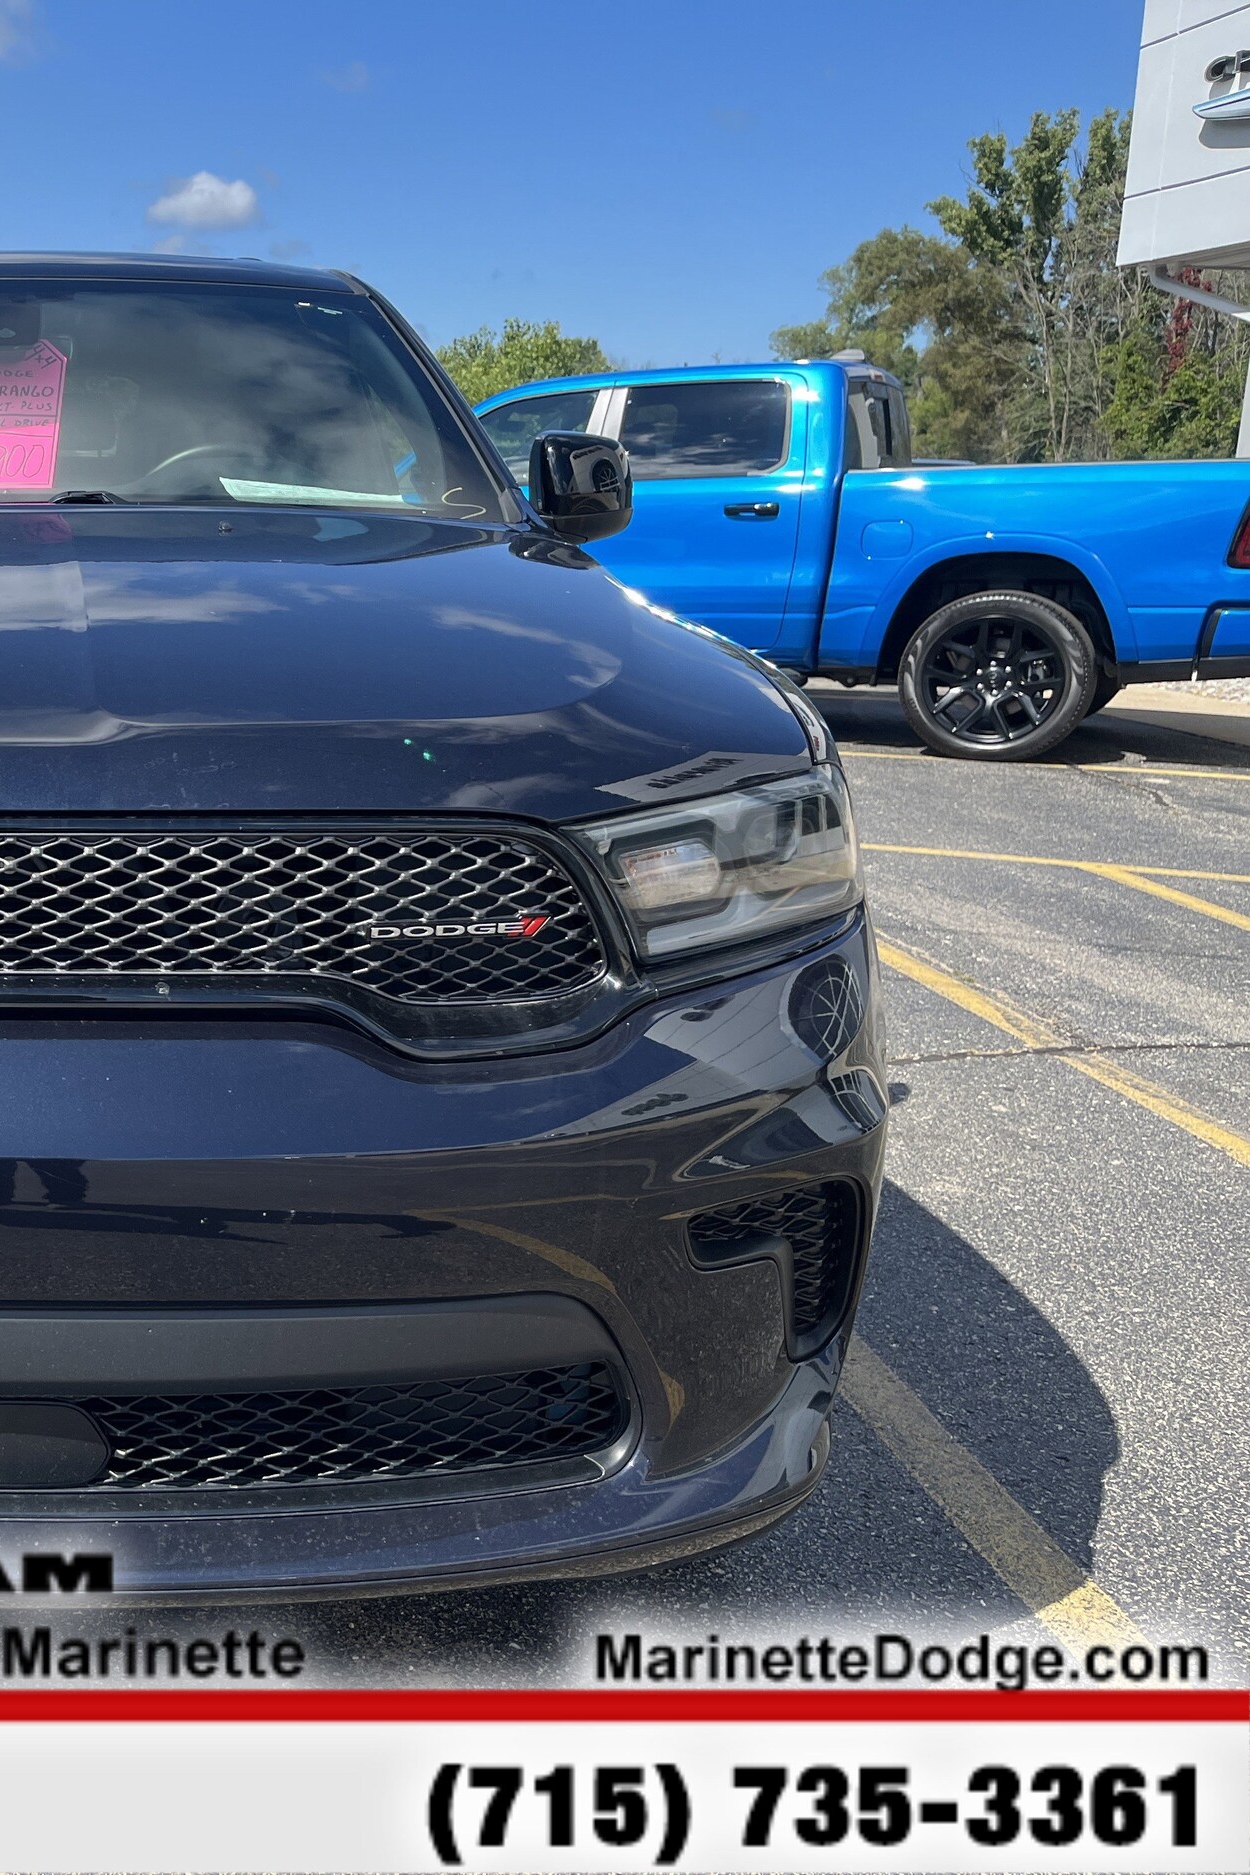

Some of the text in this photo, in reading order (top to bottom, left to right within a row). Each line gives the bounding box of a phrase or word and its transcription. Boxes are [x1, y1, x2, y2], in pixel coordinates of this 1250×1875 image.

[20, 400, 53, 412] PLUS
[15, 418, 51, 427] DRIVE
[370, 922, 524, 939] DODGE
